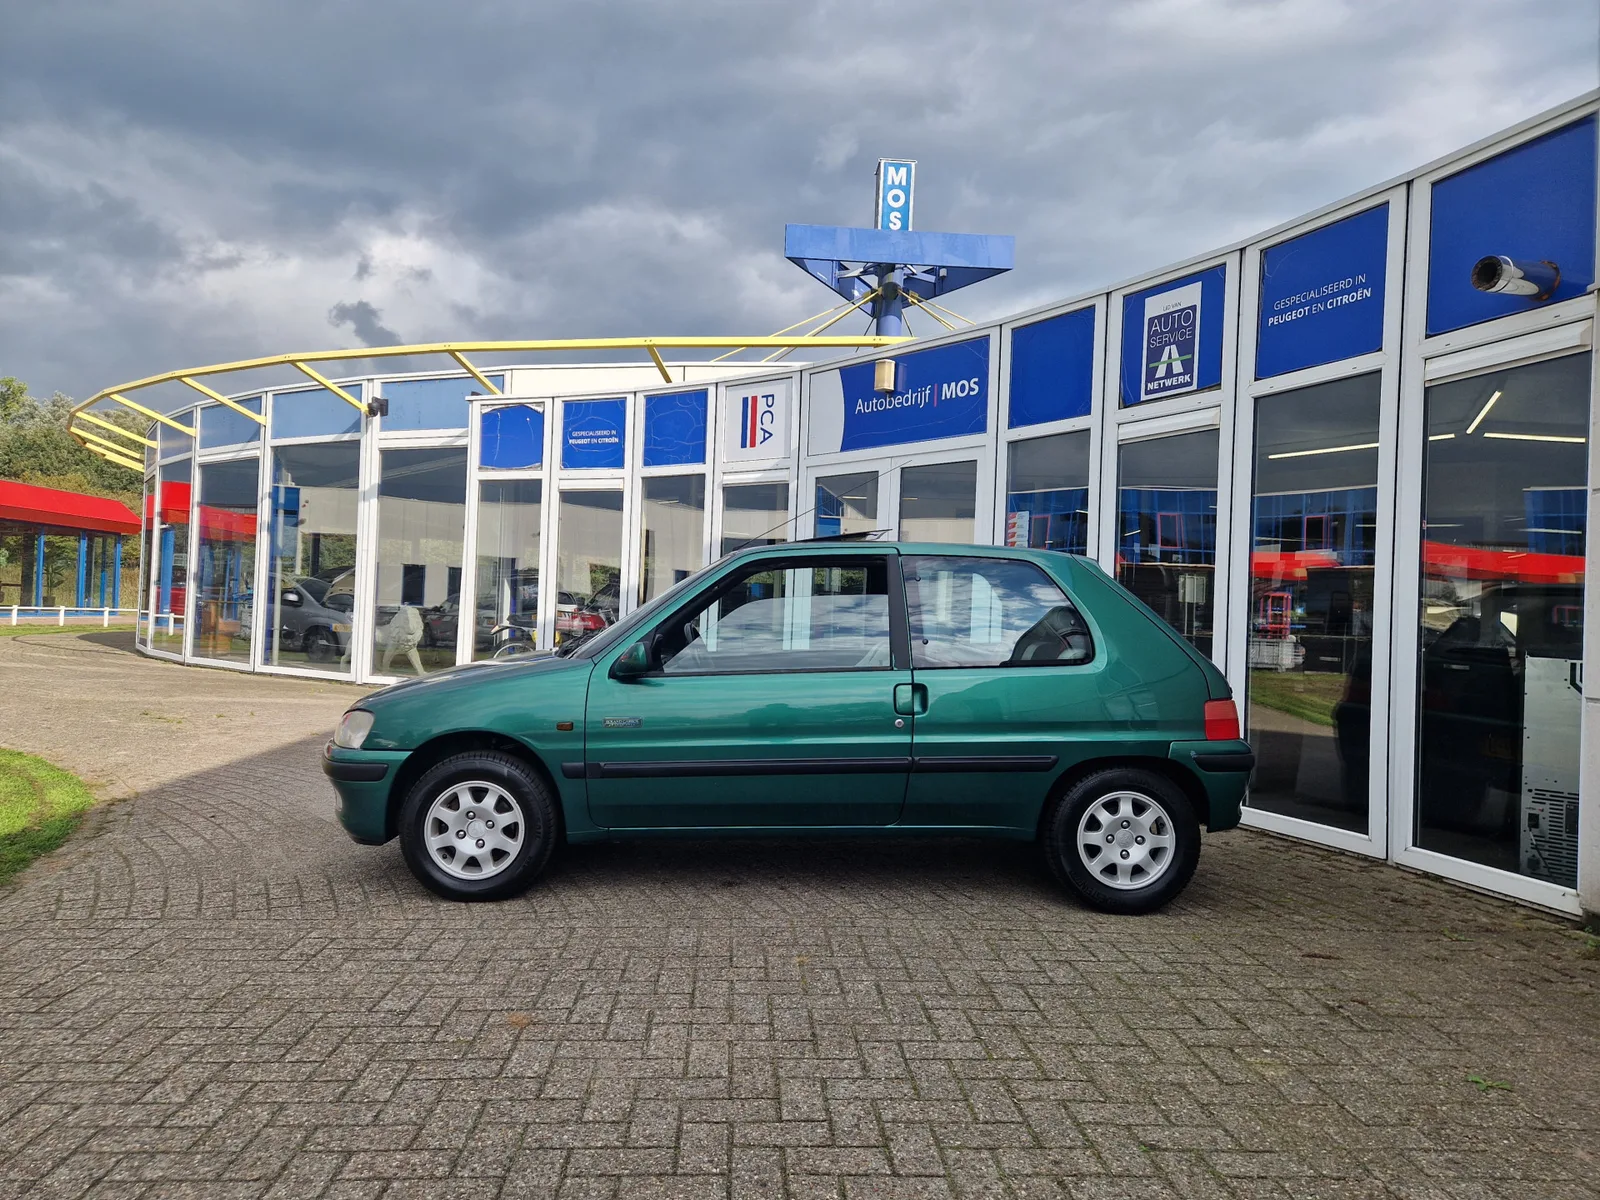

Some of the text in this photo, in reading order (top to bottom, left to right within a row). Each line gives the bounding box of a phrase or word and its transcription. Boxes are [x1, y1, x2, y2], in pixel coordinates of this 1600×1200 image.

[887, 166, 907, 231] MOS
[1267, 287, 1372, 327] PEUGEOT EN CITROËN
[1273, 273, 1366, 311] GESPECIALISEERD IN
[1149, 327, 1193, 348] SERVICE
[1150, 309, 1193, 335] AUTO
[854, 378, 979, 414] Autobedrijf MOS
[1147, 374, 1191, 390] NETWERK
[760, 394, 774, 445] PCA
